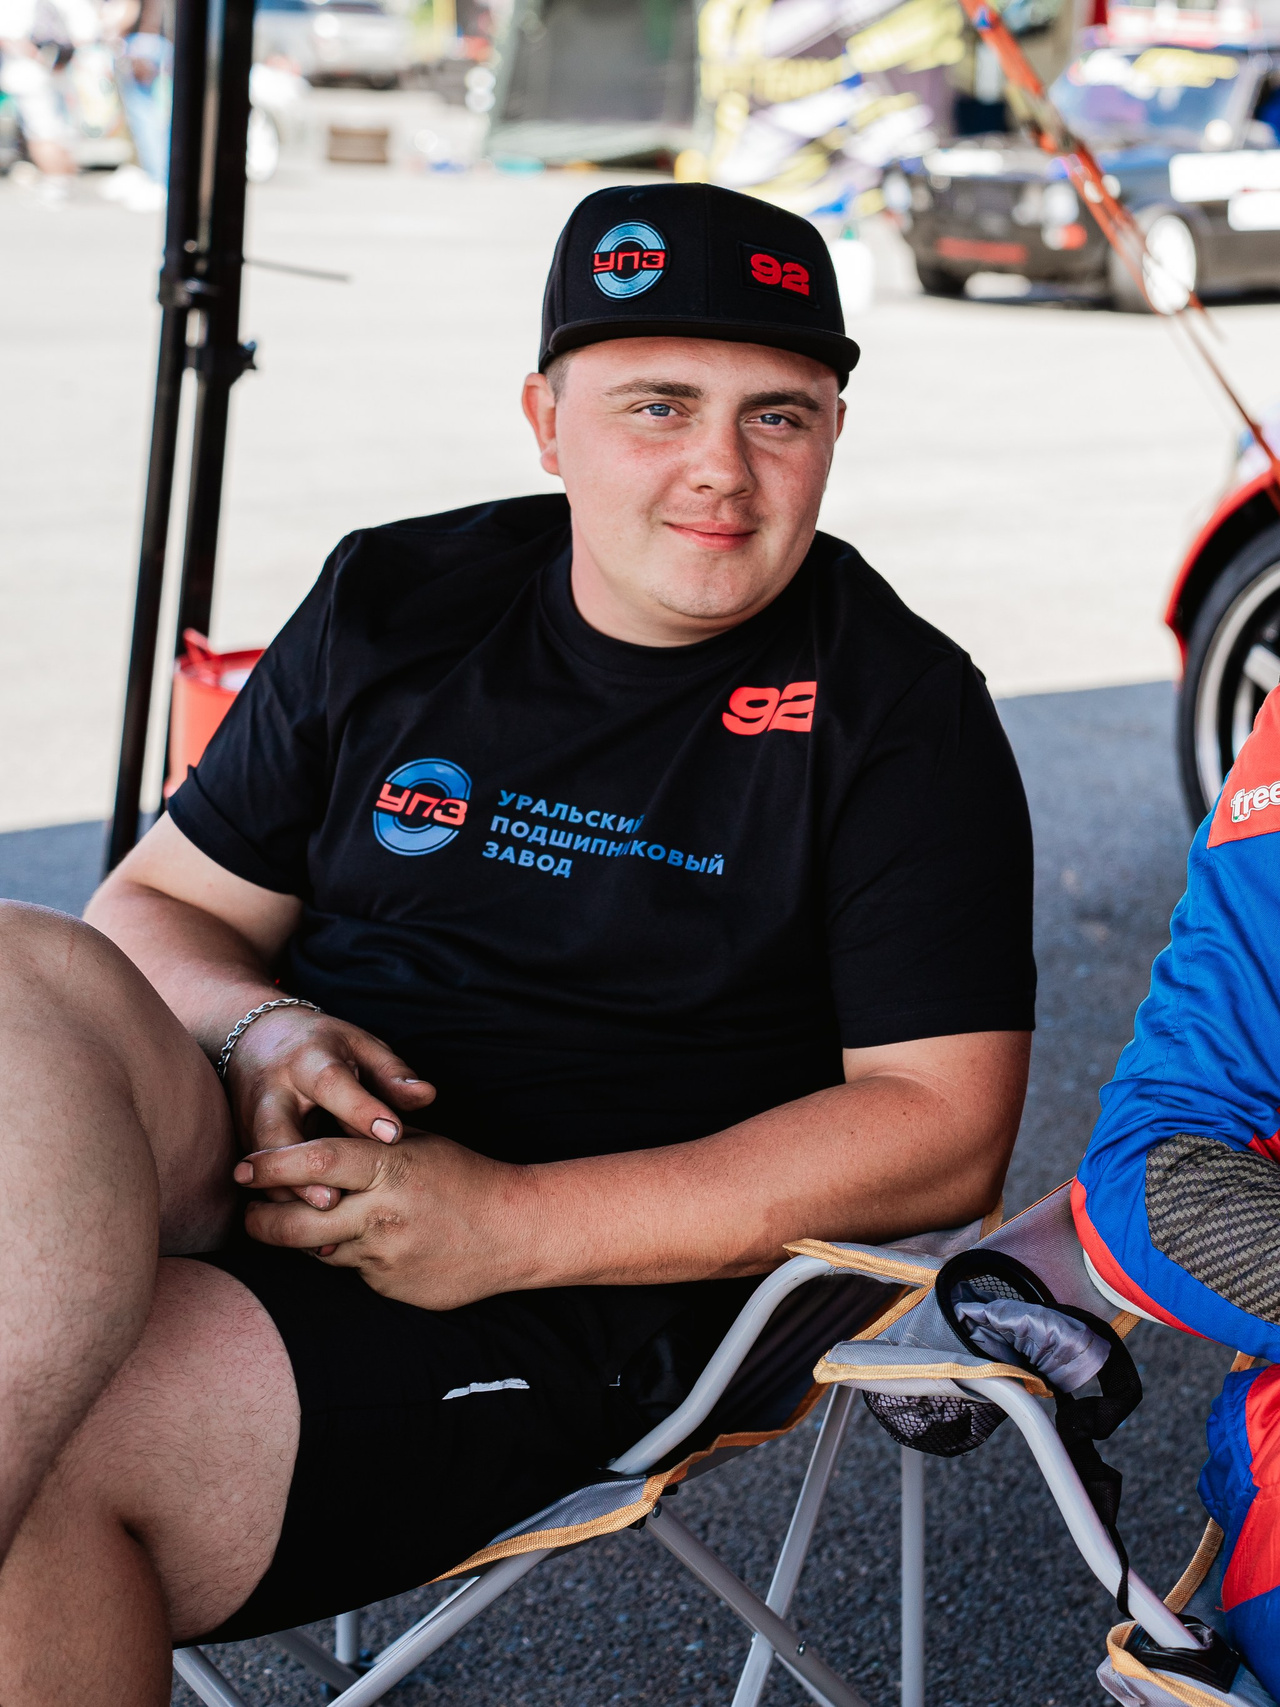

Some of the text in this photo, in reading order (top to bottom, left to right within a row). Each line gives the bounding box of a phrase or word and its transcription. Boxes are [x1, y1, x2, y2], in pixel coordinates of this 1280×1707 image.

[593, 251, 666, 273] УПЗ
[750, 253, 810, 297] 92
[722, 681, 817, 736] 92
[375, 782, 468, 827] УПЗ
[482, 841, 573, 879] ЗАВОД
